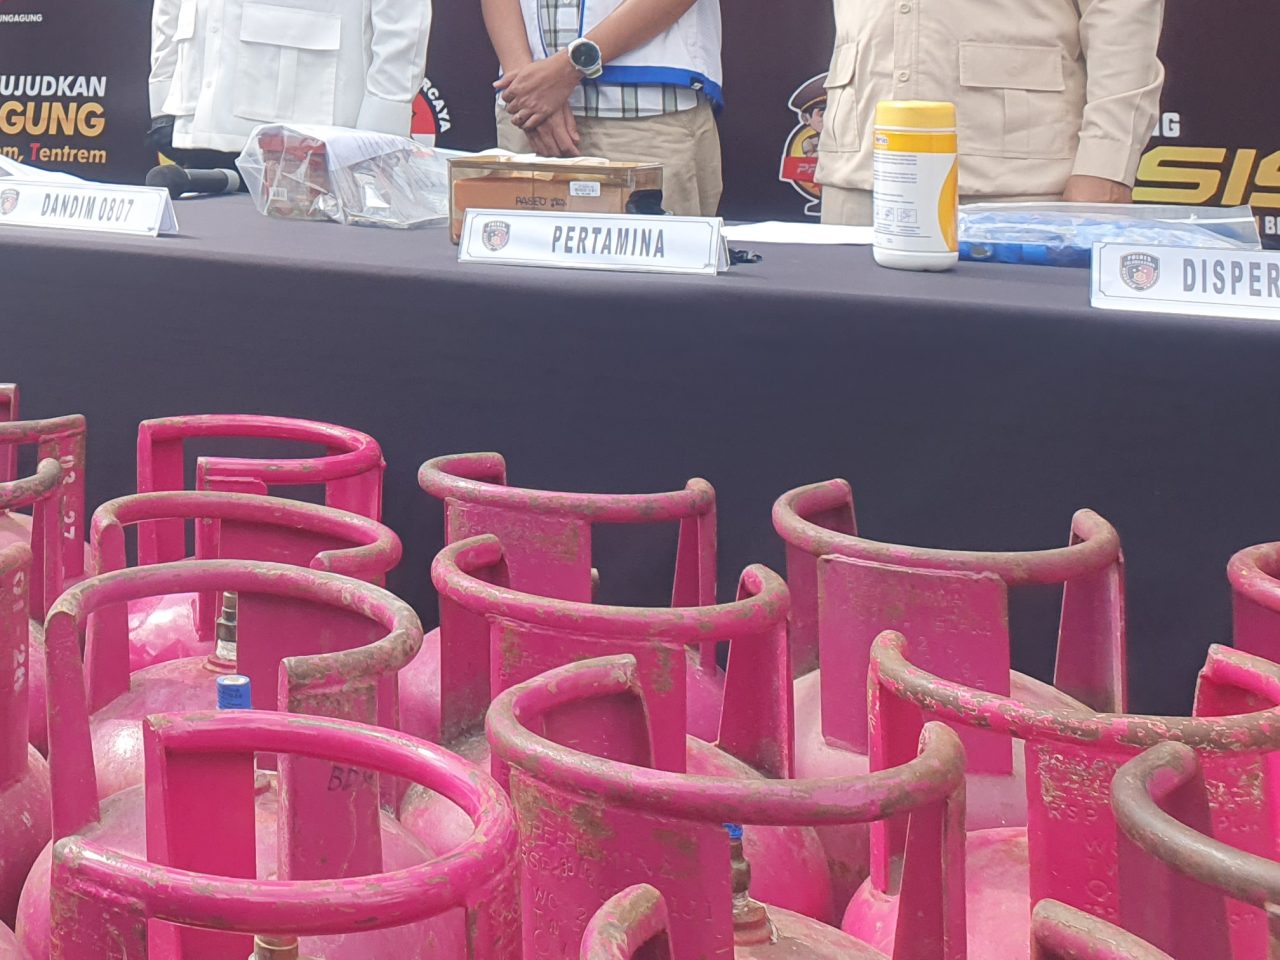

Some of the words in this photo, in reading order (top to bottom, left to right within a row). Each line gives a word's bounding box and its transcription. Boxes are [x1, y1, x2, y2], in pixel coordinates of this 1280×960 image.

[29, 142, 107, 163] Tentrem
[41, 193, 96, 220] DANDIM
[98, 197, 135, 223] 0807
[552, 225, 665, 258] PERTAMINA
